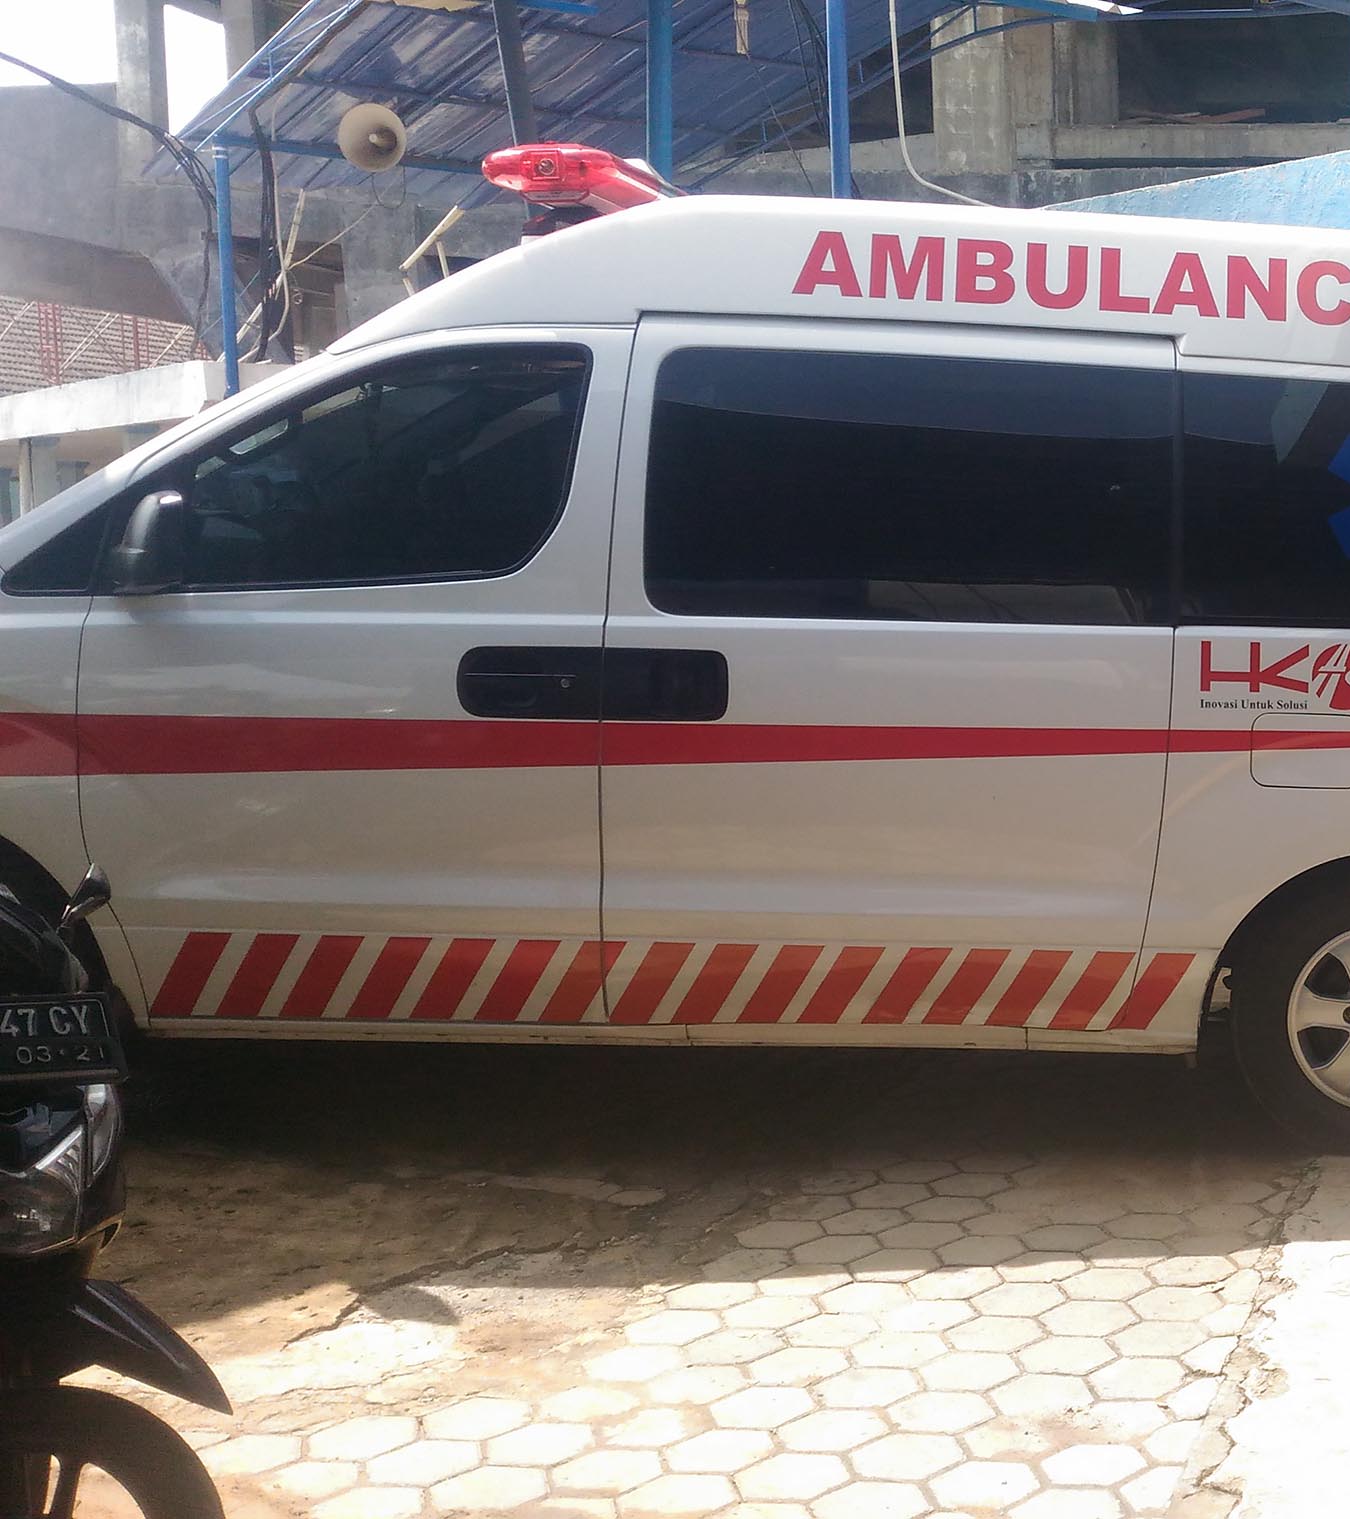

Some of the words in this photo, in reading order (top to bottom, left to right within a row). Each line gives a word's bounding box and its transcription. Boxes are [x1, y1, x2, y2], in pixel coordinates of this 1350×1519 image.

[1200, 699, 1238, 709] Inovasi
[1241, 700, 1274, 710] Untuk
[1276, 700, 1308, 710] Solusi
[49, 1004, 88, 1035] CY
